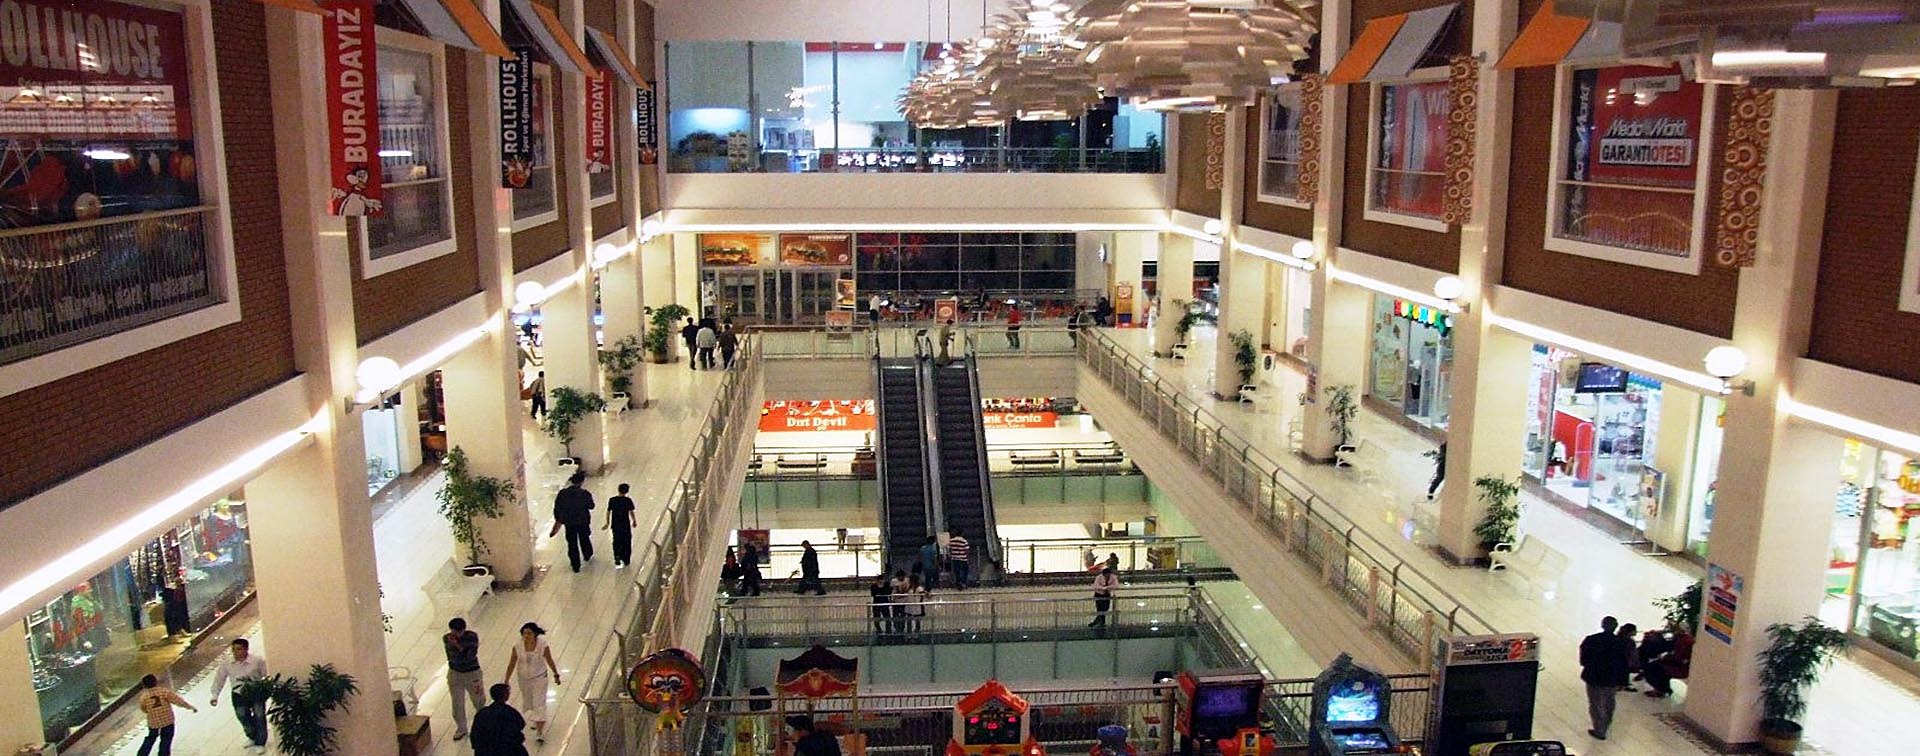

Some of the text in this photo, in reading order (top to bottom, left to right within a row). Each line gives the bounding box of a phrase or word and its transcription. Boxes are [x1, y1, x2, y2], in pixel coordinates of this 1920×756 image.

[337, 8, 368, 163] BURADAYIZ
[639, 89, 649, 144] ROLLHOUS
[813, 416, 847, 427] Devil
[1004, 412, 1042, 424] Çanta
